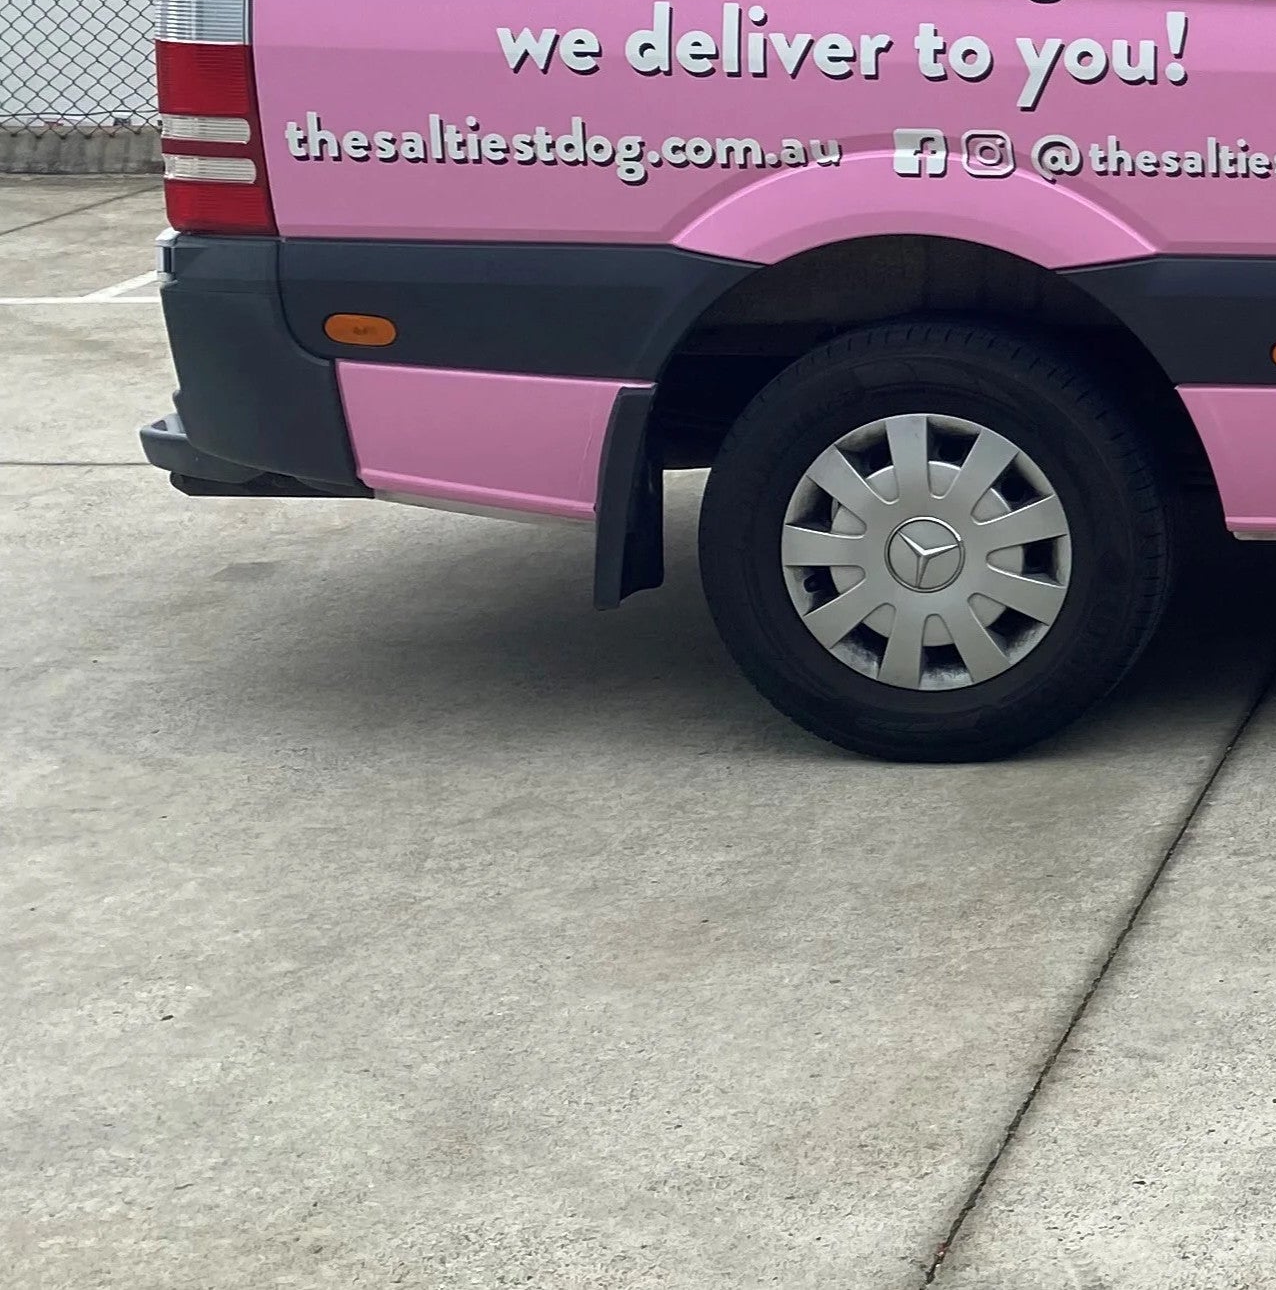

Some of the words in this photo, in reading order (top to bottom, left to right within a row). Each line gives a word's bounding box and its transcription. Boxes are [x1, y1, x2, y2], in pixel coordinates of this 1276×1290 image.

[496, 22, 602, 75] we
[624, 0, 893, 78] deliver
[915, 22, 993, 80] to
[1015, 9, 1190, 111] you!
[285, 111, 842, 184] thesaltiestdog.com.au
